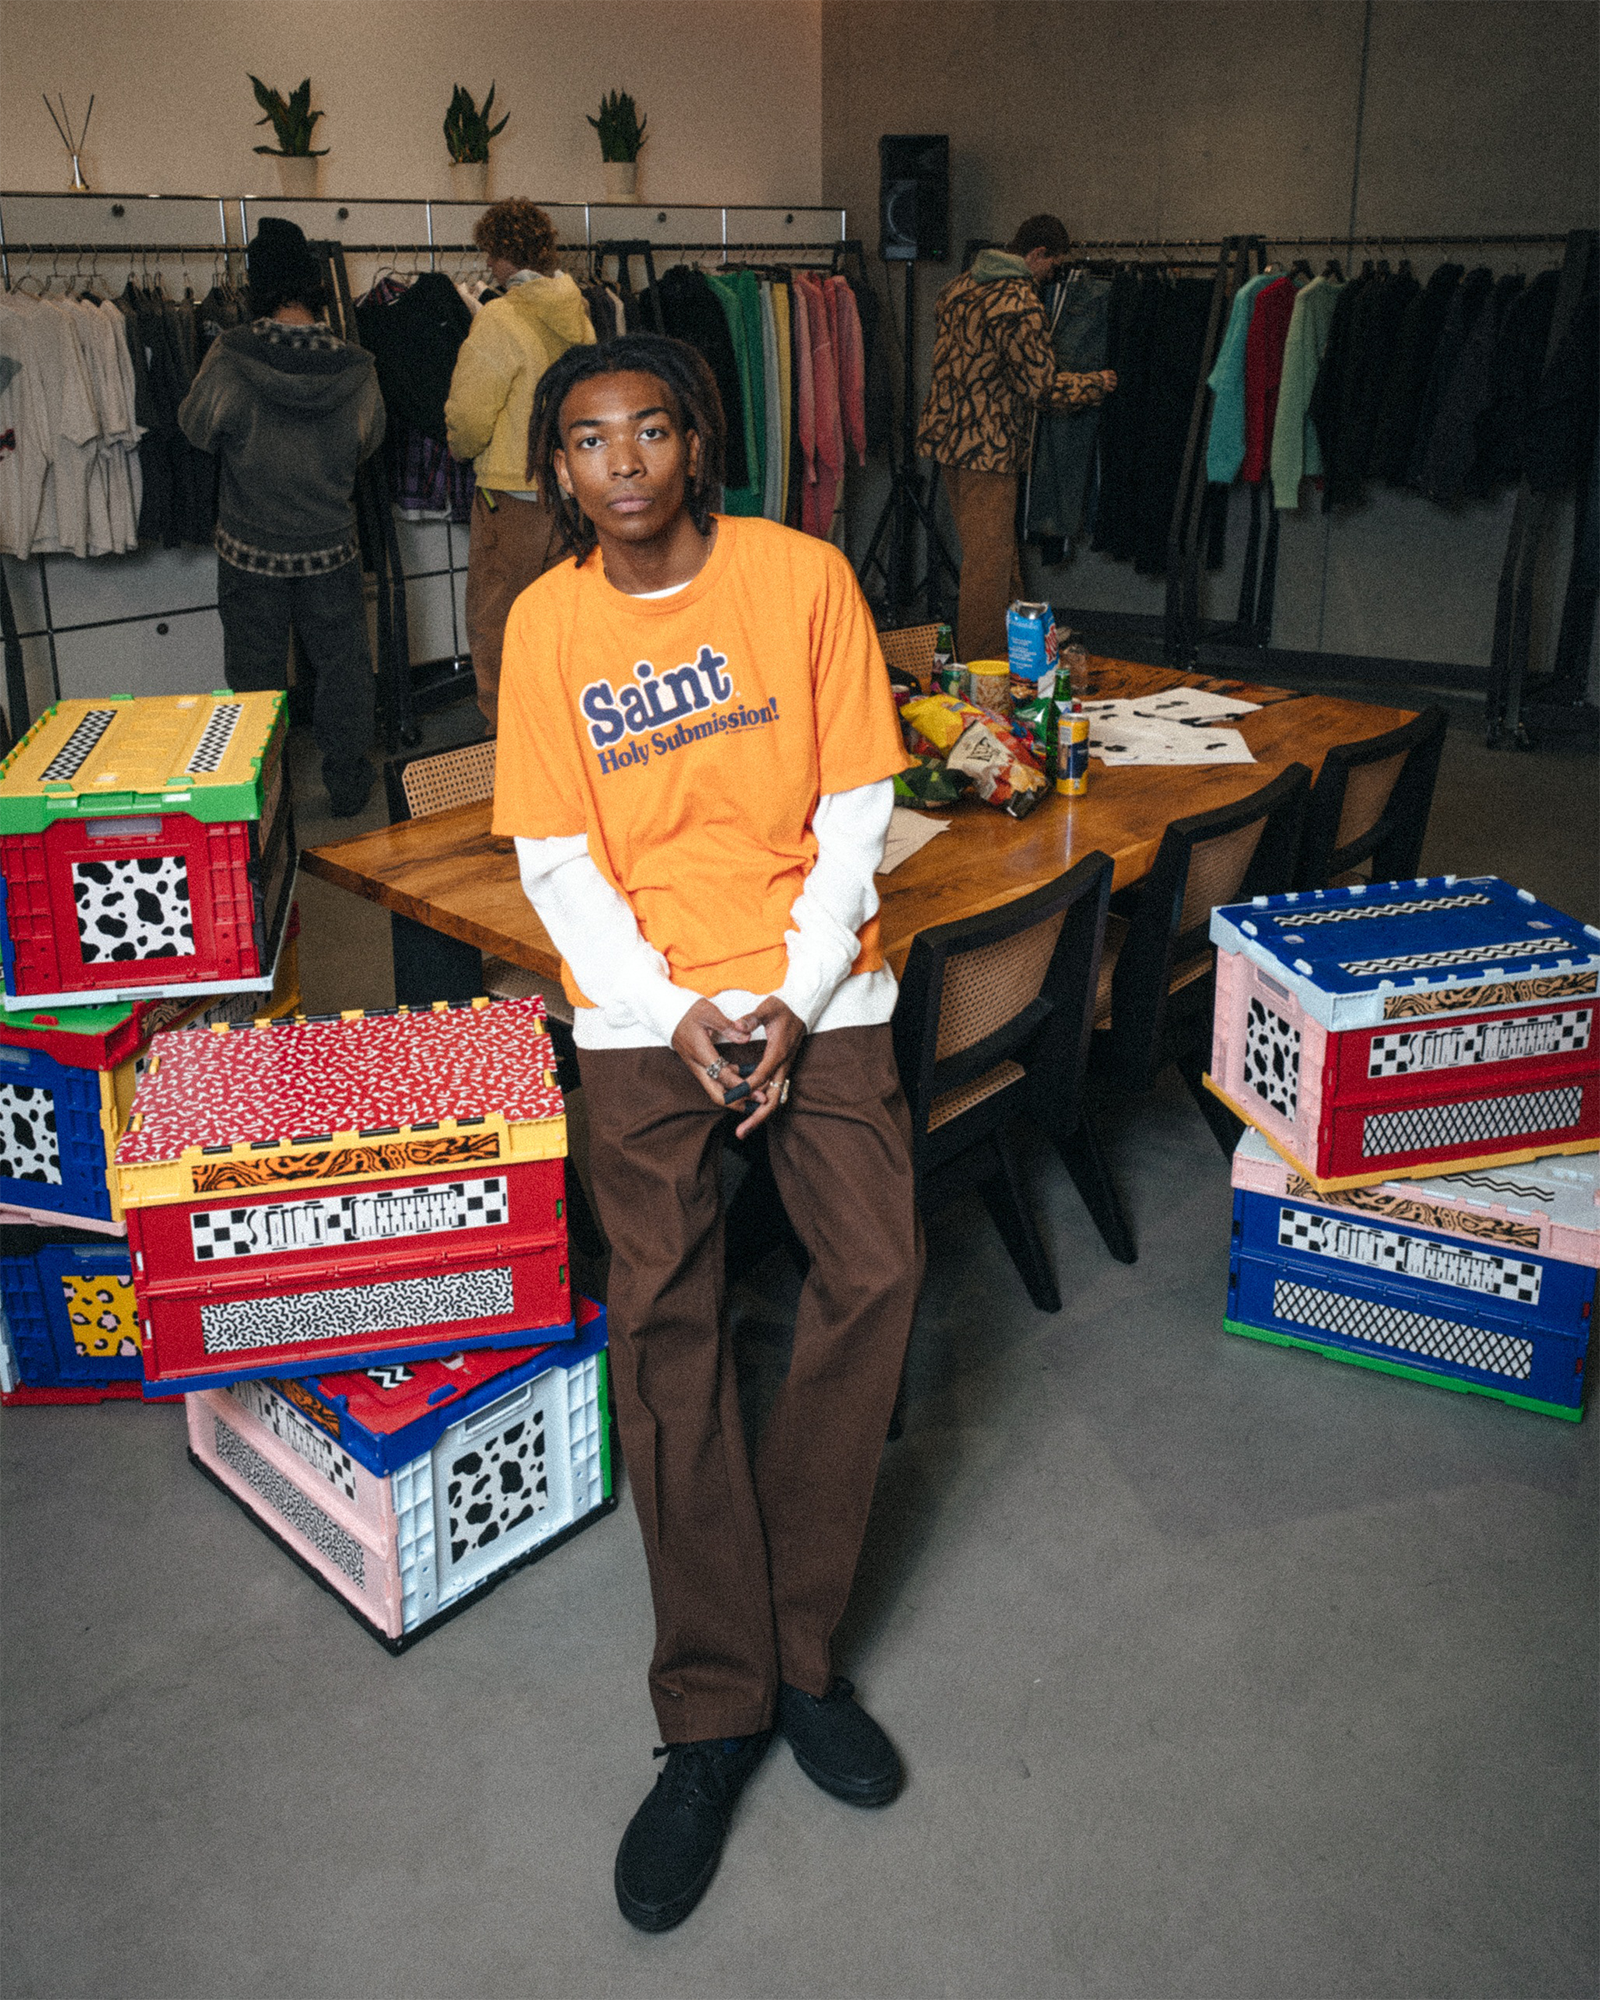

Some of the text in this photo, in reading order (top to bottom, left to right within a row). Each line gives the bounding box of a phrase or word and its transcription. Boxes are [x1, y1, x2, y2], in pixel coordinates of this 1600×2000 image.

[580, 645, 734, 749] Saint
[597, 696, 780, 775] Holy Submission!
[1408, 1031, 1466, 1067] SAINT
[244, 1204, 328, 1248] SAINT
[1320, 1219, 1388, 1267] SAINT
